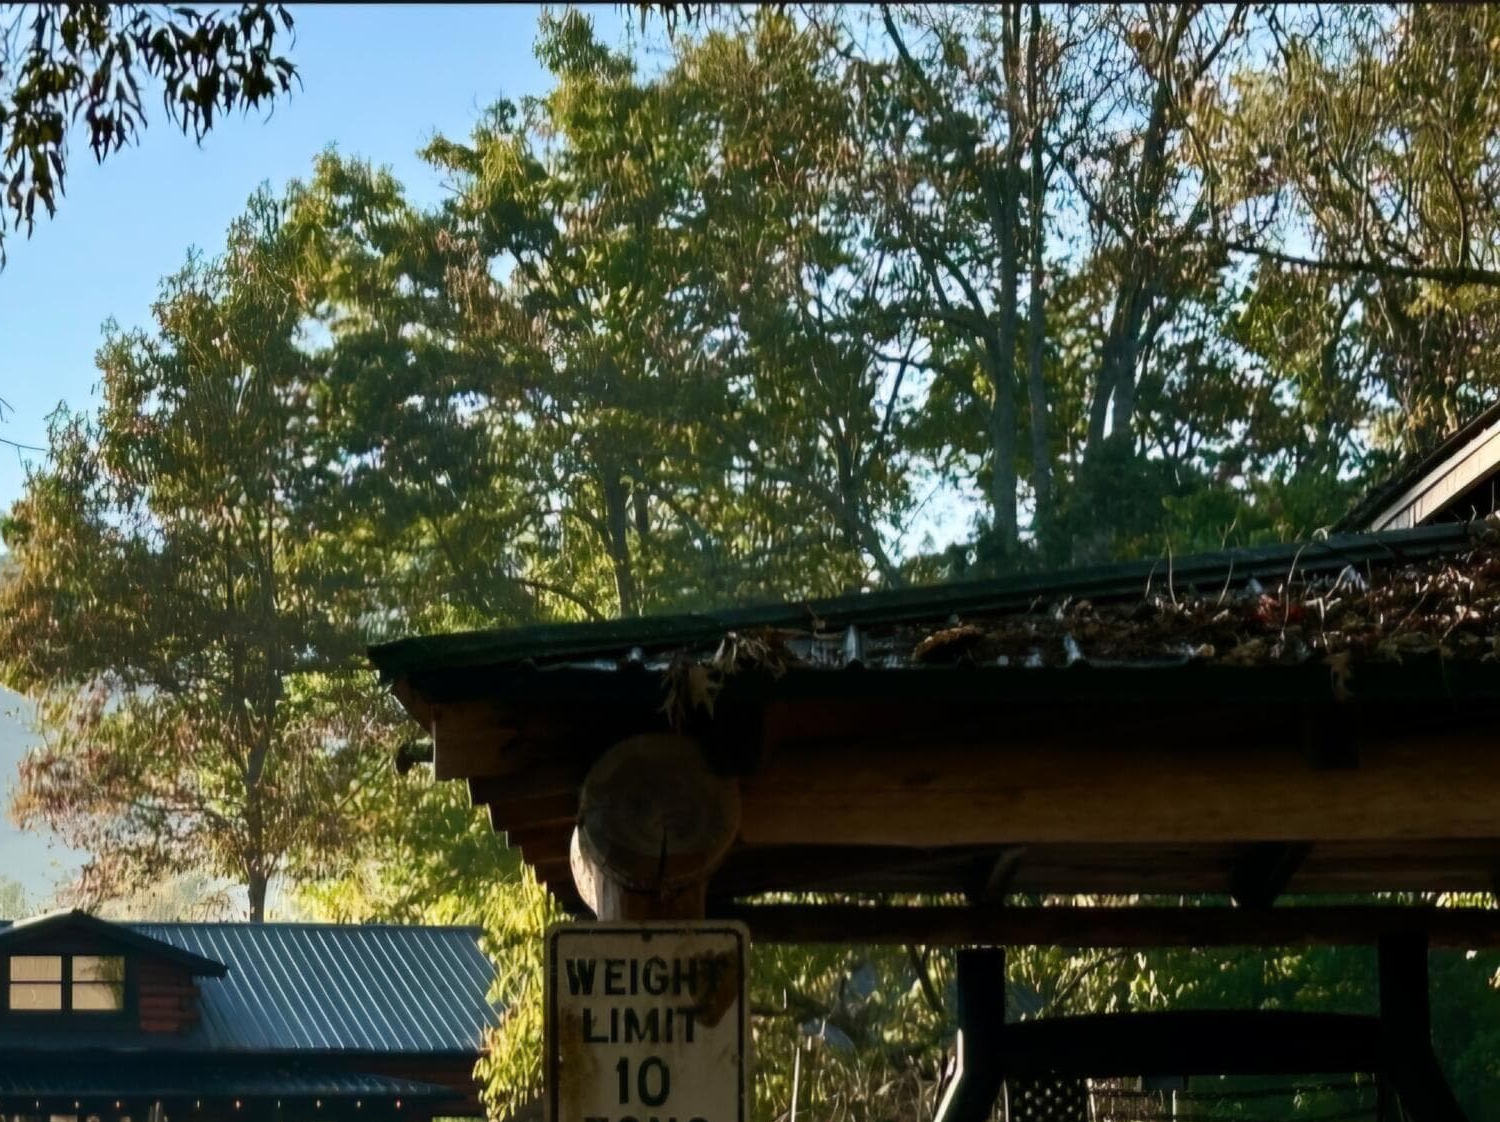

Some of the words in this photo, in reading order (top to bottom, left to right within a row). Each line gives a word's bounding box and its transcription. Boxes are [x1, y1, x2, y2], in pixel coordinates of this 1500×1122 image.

[565, 957, 728, 996] WEIGHT
[582, 1007, 703, 1044] LIMIT
[615, 1056, 671, 1107] 10
